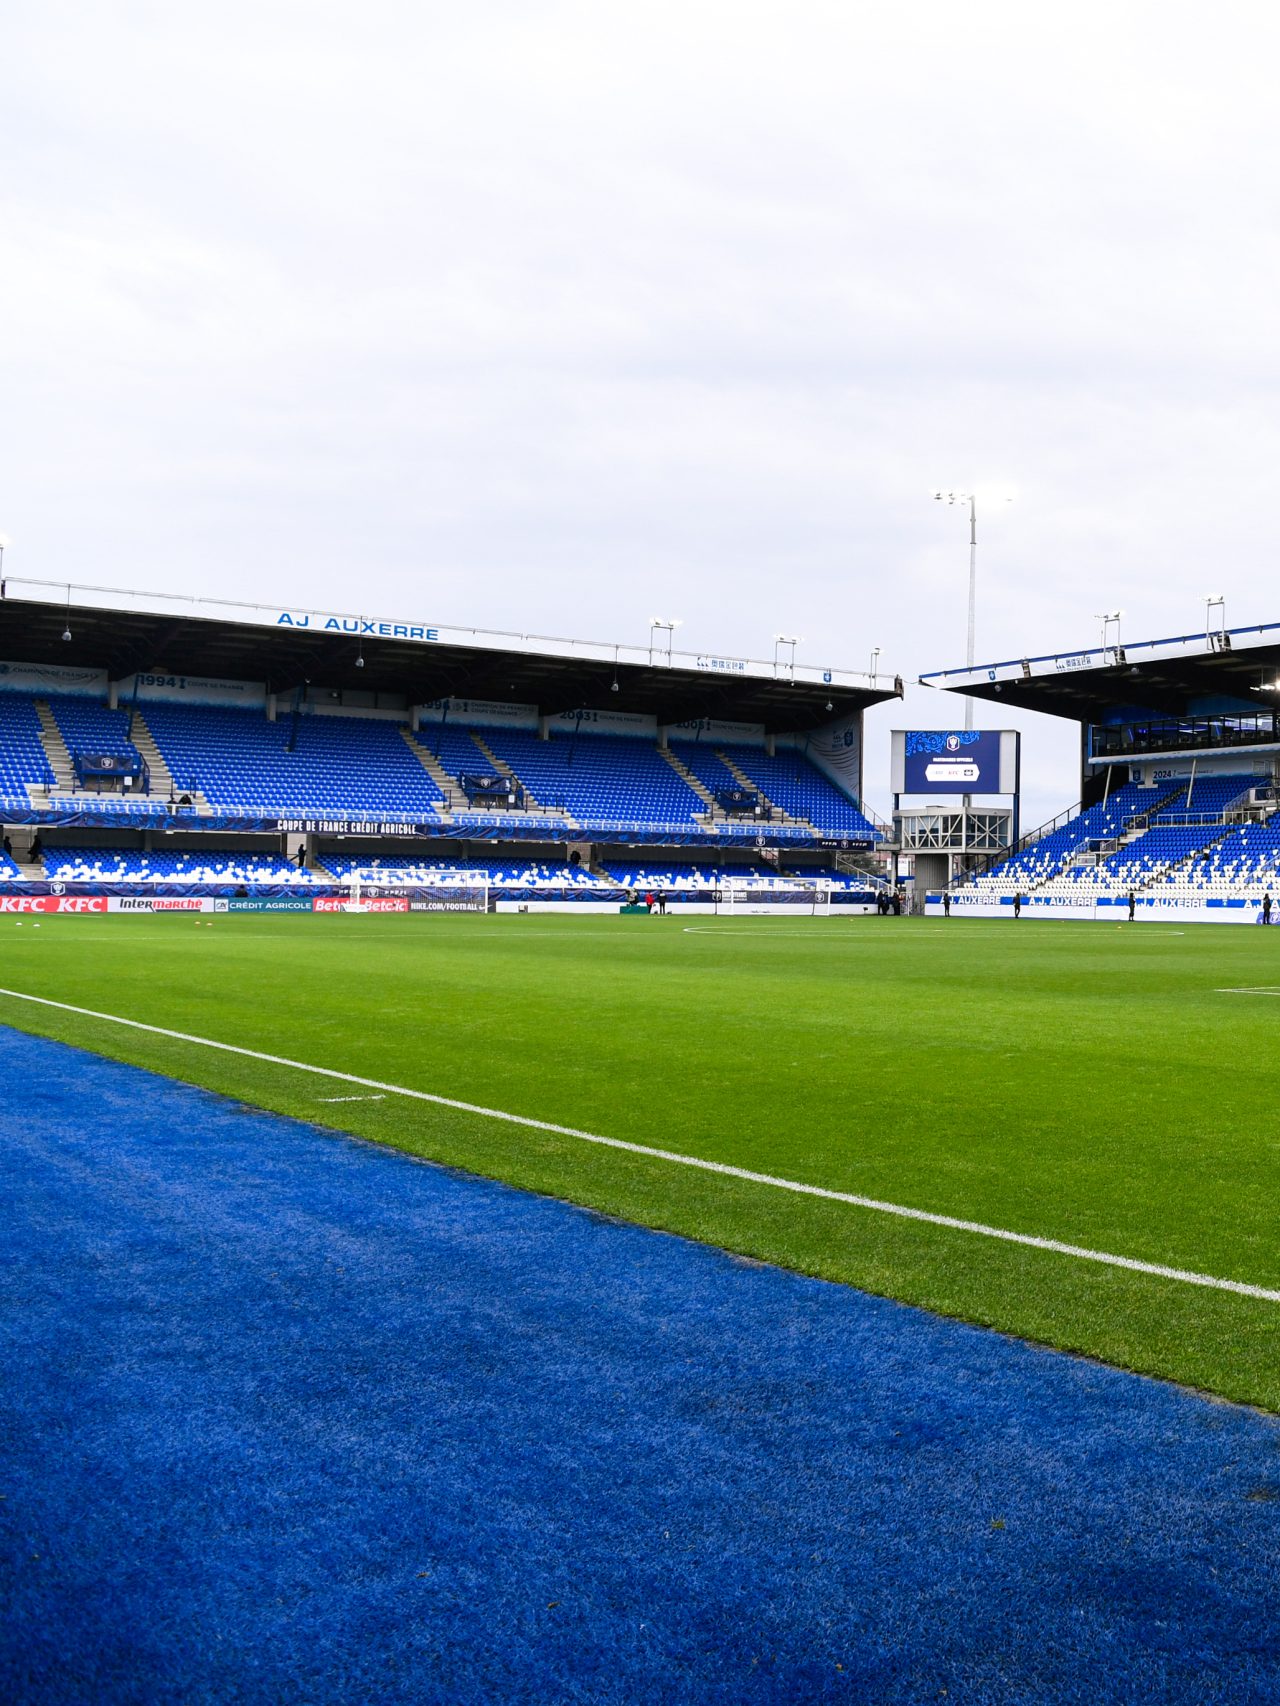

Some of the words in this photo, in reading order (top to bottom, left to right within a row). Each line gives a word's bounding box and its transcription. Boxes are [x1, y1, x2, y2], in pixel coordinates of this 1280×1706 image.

[277, 613, 309, 627] AJ
[324, 618, 439, 641] AUXERRE
[137, 673, 176, 688] 1994
[1153, 770, 1172, 779] 2024
[277, 820, 303, 831] COUPE
[306, 821, 316, 831] DE
[319, 821, 349, 832] FRANCE
[351, 820, 378, 833] CRÉDIT
[380, 823, 416, 835] AGRICOLE
[0, 898, 46, 912] KFC
[57, 898, 103, 912] KFC
[119, 898, 203, 910] Intermarché
[229, 899, 264, 910] CRÉDIT
[265, 901, 311, 910] AGRICOLE
[960, 896, 1001, 905] AUXERRE
[1050, 897, 1098, 907] AUXERRE
[1153, 899, 1207, 908] AUXERRE
[410, 902, 478, 911] NIKE.COM/FOOTBALL
